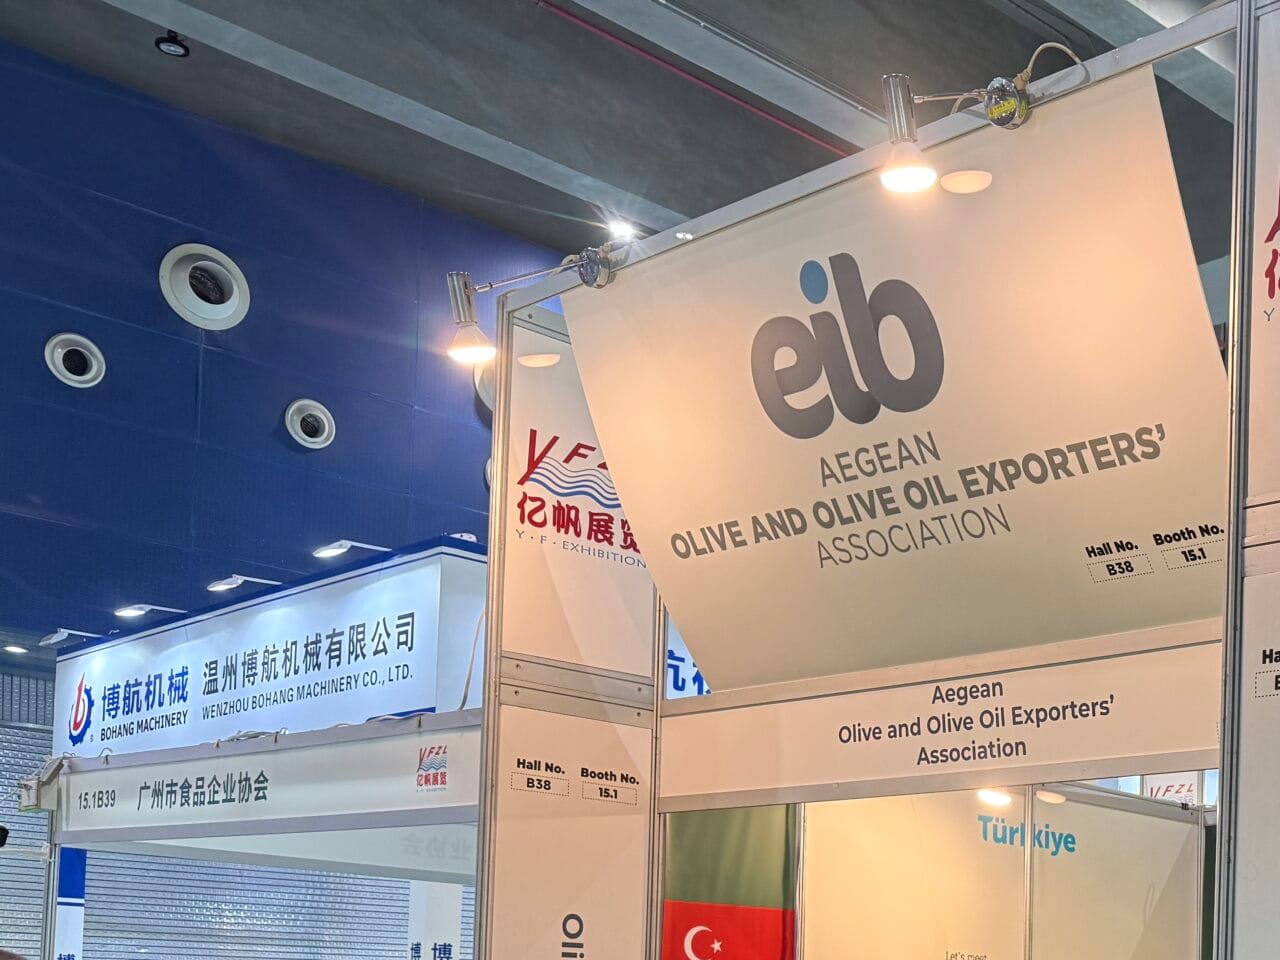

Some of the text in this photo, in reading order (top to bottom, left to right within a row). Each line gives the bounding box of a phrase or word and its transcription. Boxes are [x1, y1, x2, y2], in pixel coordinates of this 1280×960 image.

[751, 252, 945, 440] eib
[819, 430, 942, 488] AEGEAN
[670, 422, 1167, 561] OLIVE AND OLIVE OIL EXPORTERS'
[816, 503, 1012, 569] ASSOCIATION
[1085, 540, 1138, 558] Hall No.
[1153, 524, 1224, 546] Booth No.
[1106, 560, 1134, 576] B38
[1181, 547, 1207, 563] 15.1
[202, 612, 416, 697] 温州博航机械有限公司
[101, 666, 189, 723] 博航机械
[202, 698, 249, 721] WENZHOU
[251, 690, 294, 710] BOHANG
[296, 674, 359, 702] MACHINERY
[931, 678, 1004, 708] Aegean
[101, 709, 189, 742] BOHANG MACHINERY
[838, 694, 1116, 746] Olive and Olive Oil Exporters'
[516, 758, 565, 774] Hall No.
[916, 737, 1027, 768] Association
[138, 770, 269, 811] 广州市食品企业协会
[526, 777, 552, 791] B38
[580, 767, 640, 785] Booth No.
[78, 789, 116, 811] 15.1B39
[598, 787, 618, 800] 15.1
